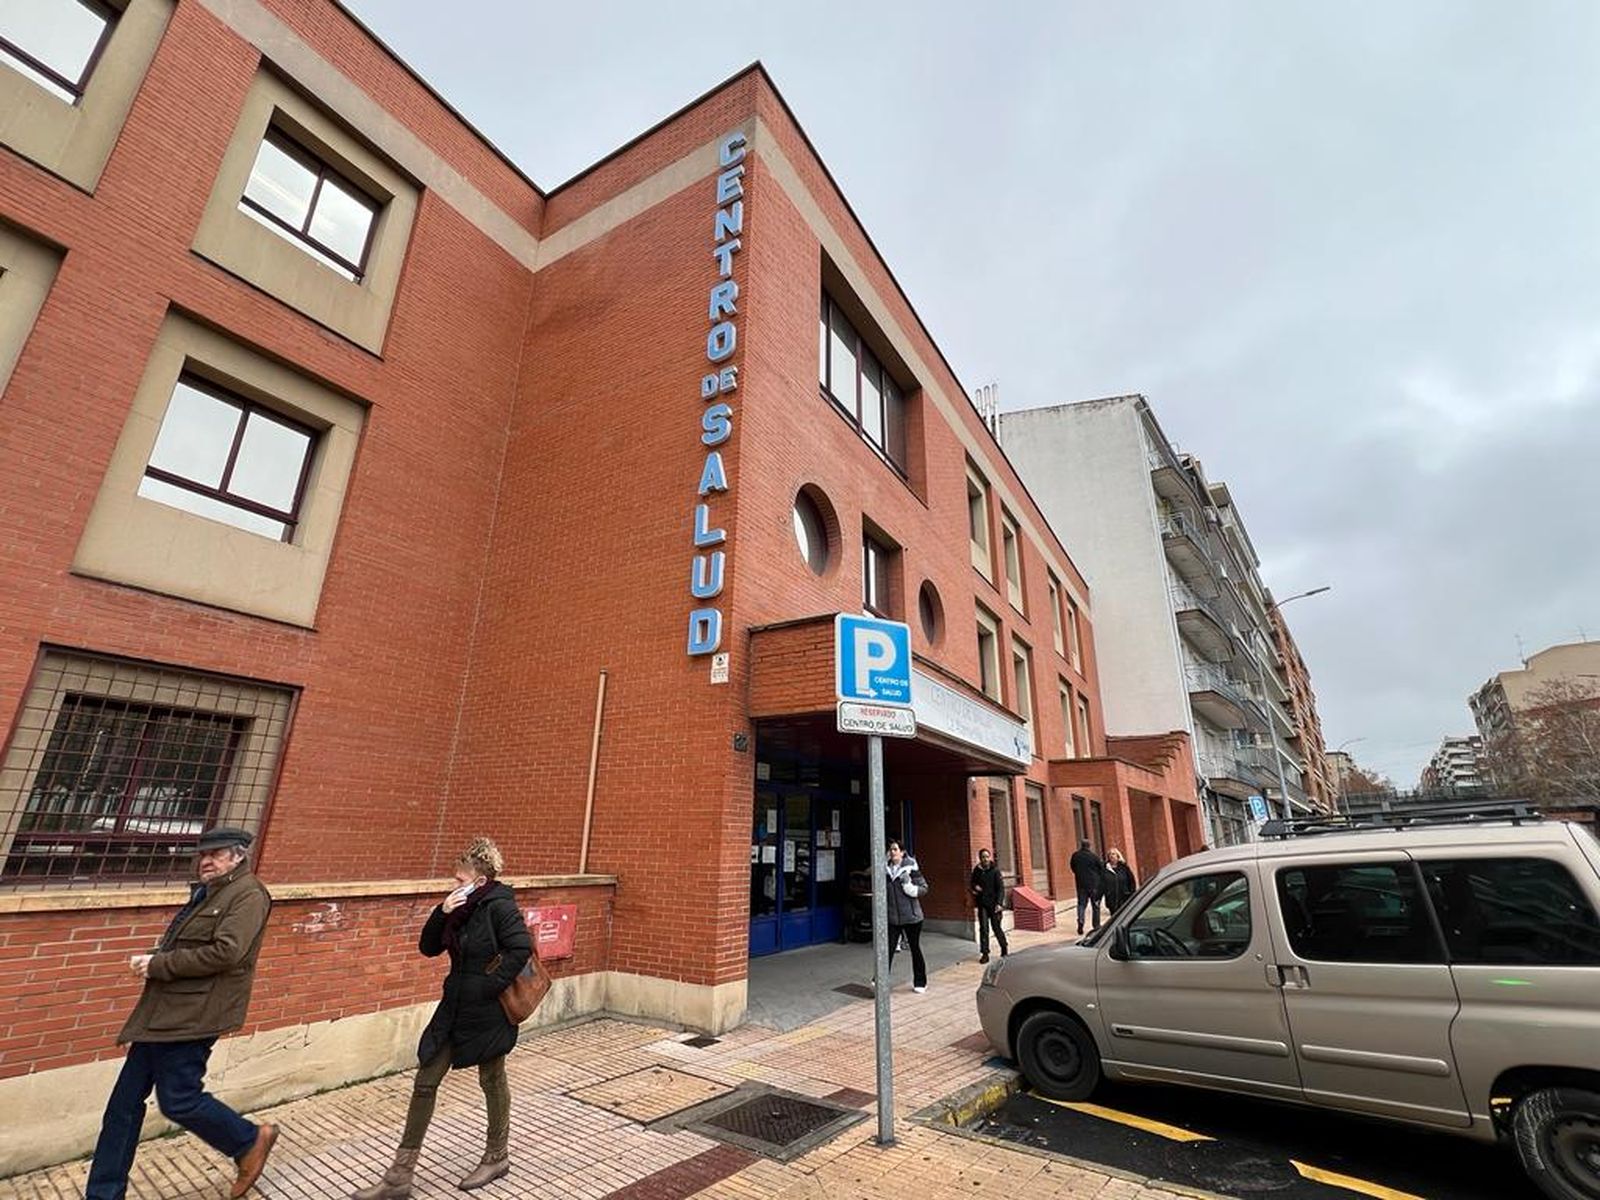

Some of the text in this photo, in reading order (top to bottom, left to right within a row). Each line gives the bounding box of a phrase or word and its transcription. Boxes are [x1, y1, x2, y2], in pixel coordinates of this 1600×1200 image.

[707, 131, 748, 364] CENTRO
[701, 366, 738, 400] DE
[687, 403, 733, 656] SALUD
[854, 627, 897, 692] P
[874, 676, 898, 686] CENTRO
[881, 687, 903, 697] SALUD
[859, 706, 897, 719] RESERVADO
[843, 718, 914, 733] CENTRO DE SALUD
